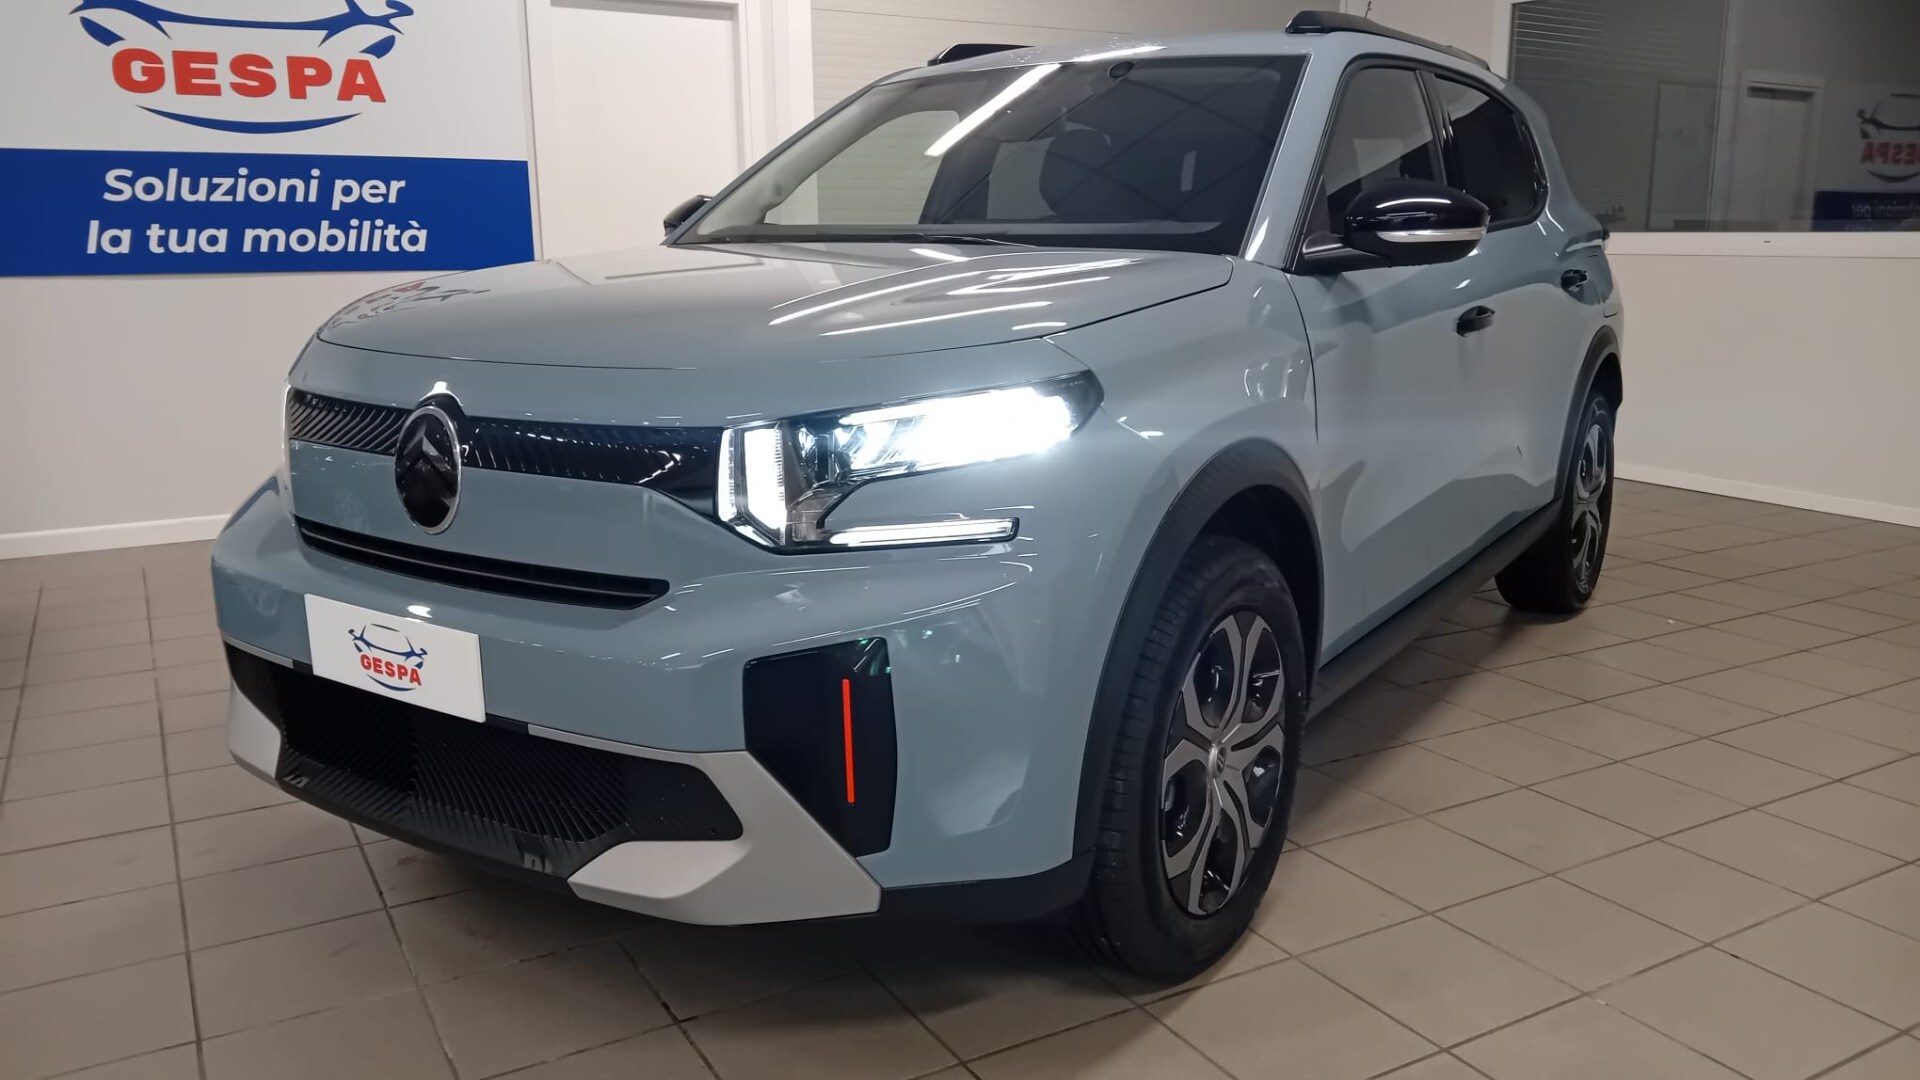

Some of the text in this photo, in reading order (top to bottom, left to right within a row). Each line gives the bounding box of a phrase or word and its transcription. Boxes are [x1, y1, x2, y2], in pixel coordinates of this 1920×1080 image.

[111, 47, 386, 103] GESPA
[103, 167, 405, 210] Soluzioni per
[87, 220, 428, 254] la tua mobilità
[360, 654, 422, 686] GESPA
